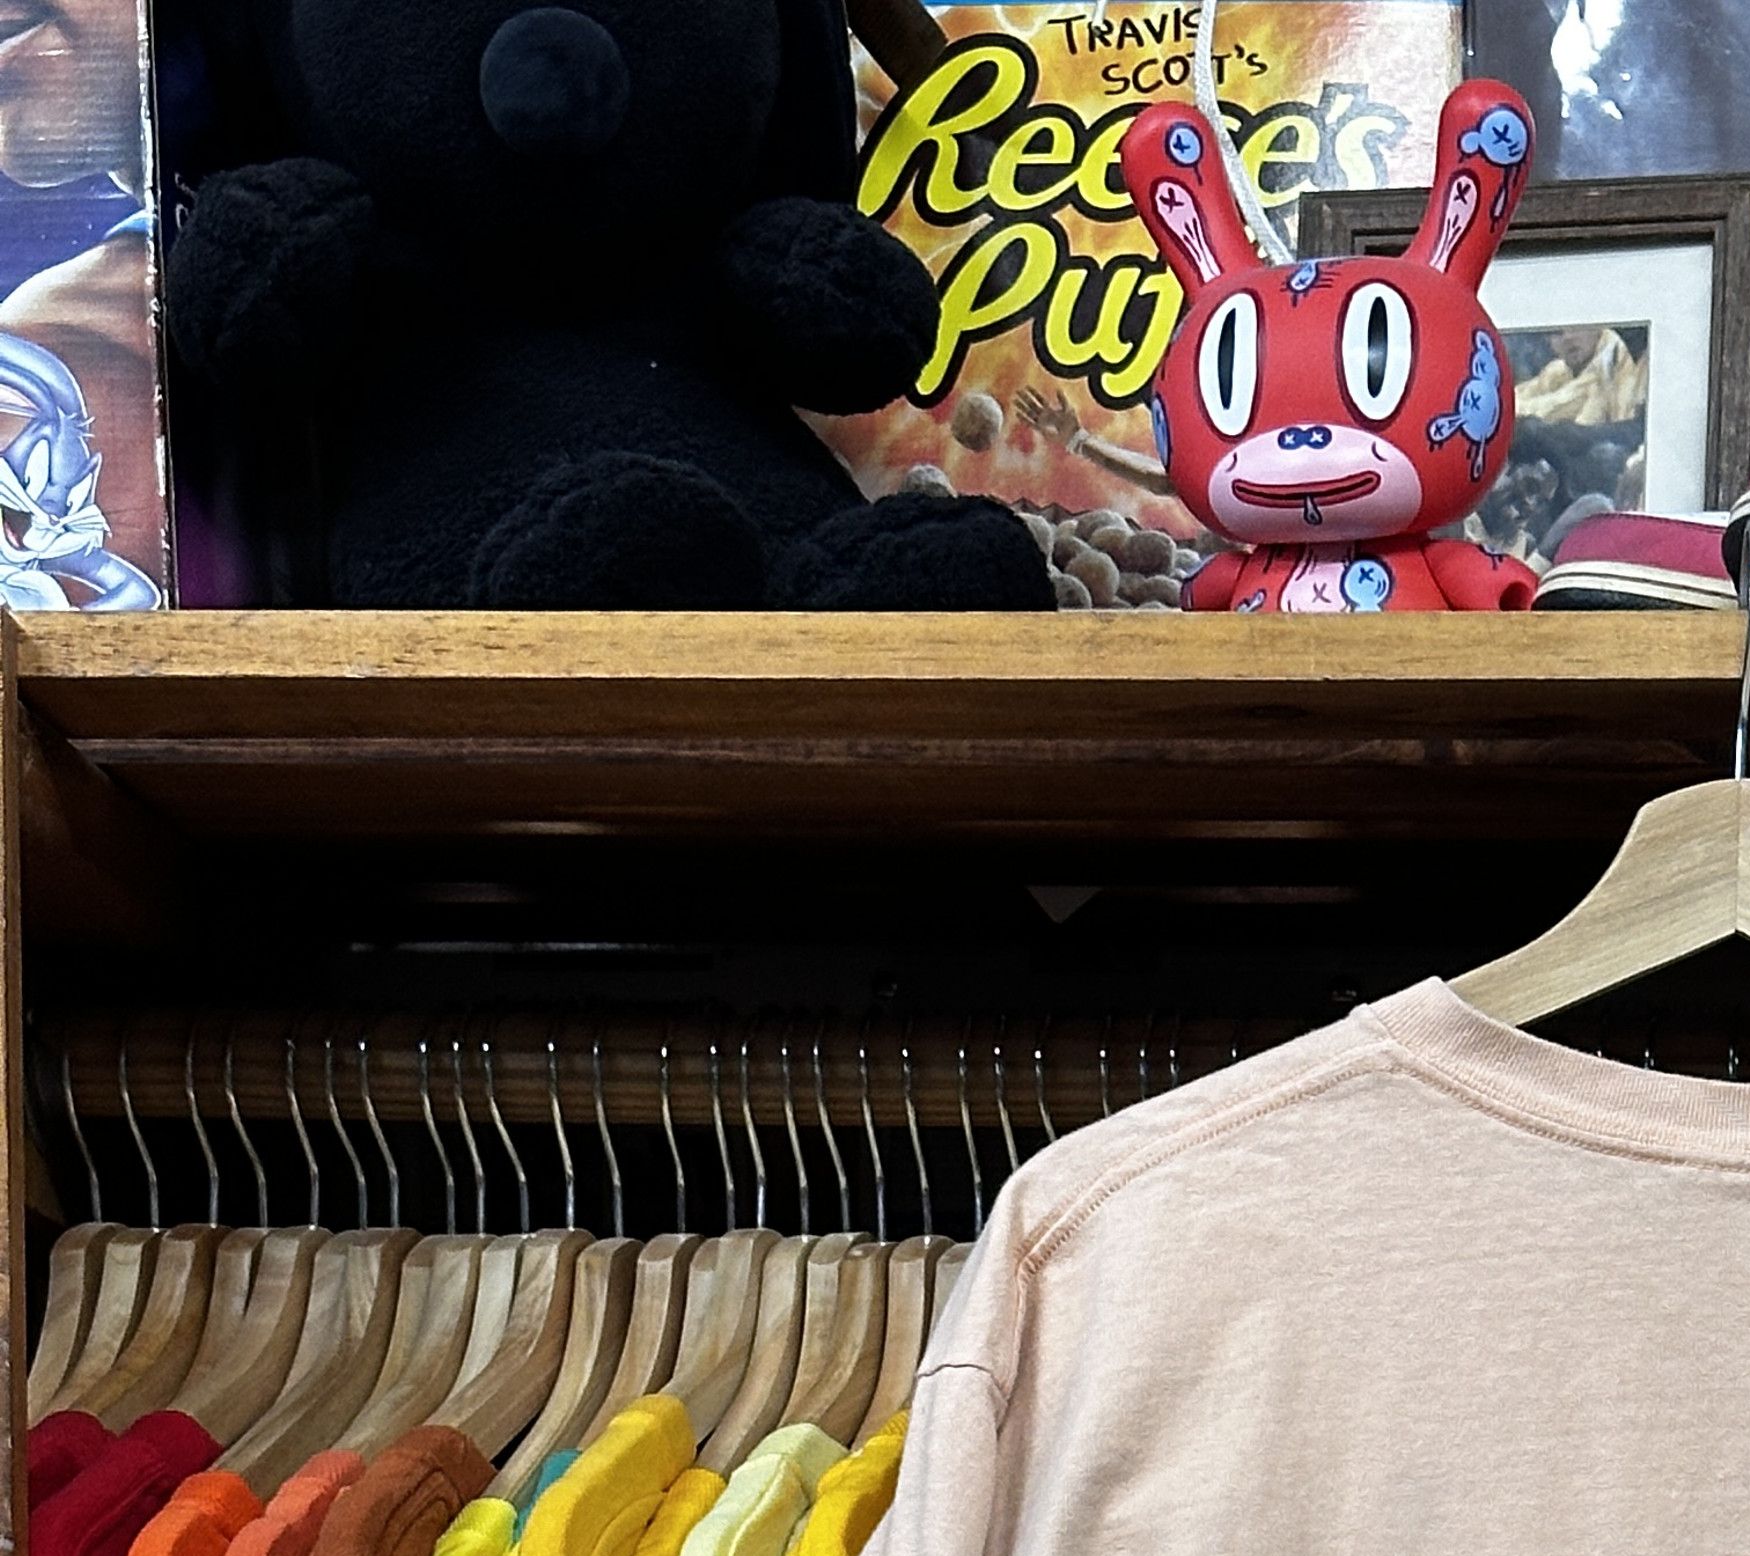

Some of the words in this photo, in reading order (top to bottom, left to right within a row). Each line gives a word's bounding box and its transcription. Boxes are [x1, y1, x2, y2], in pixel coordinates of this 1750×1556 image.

[1047, 8, 1202, 55] TRAVIS
[1101, 44, 1268, 96] SCOT'S
[857, 45, 1397, 217] Reee's
